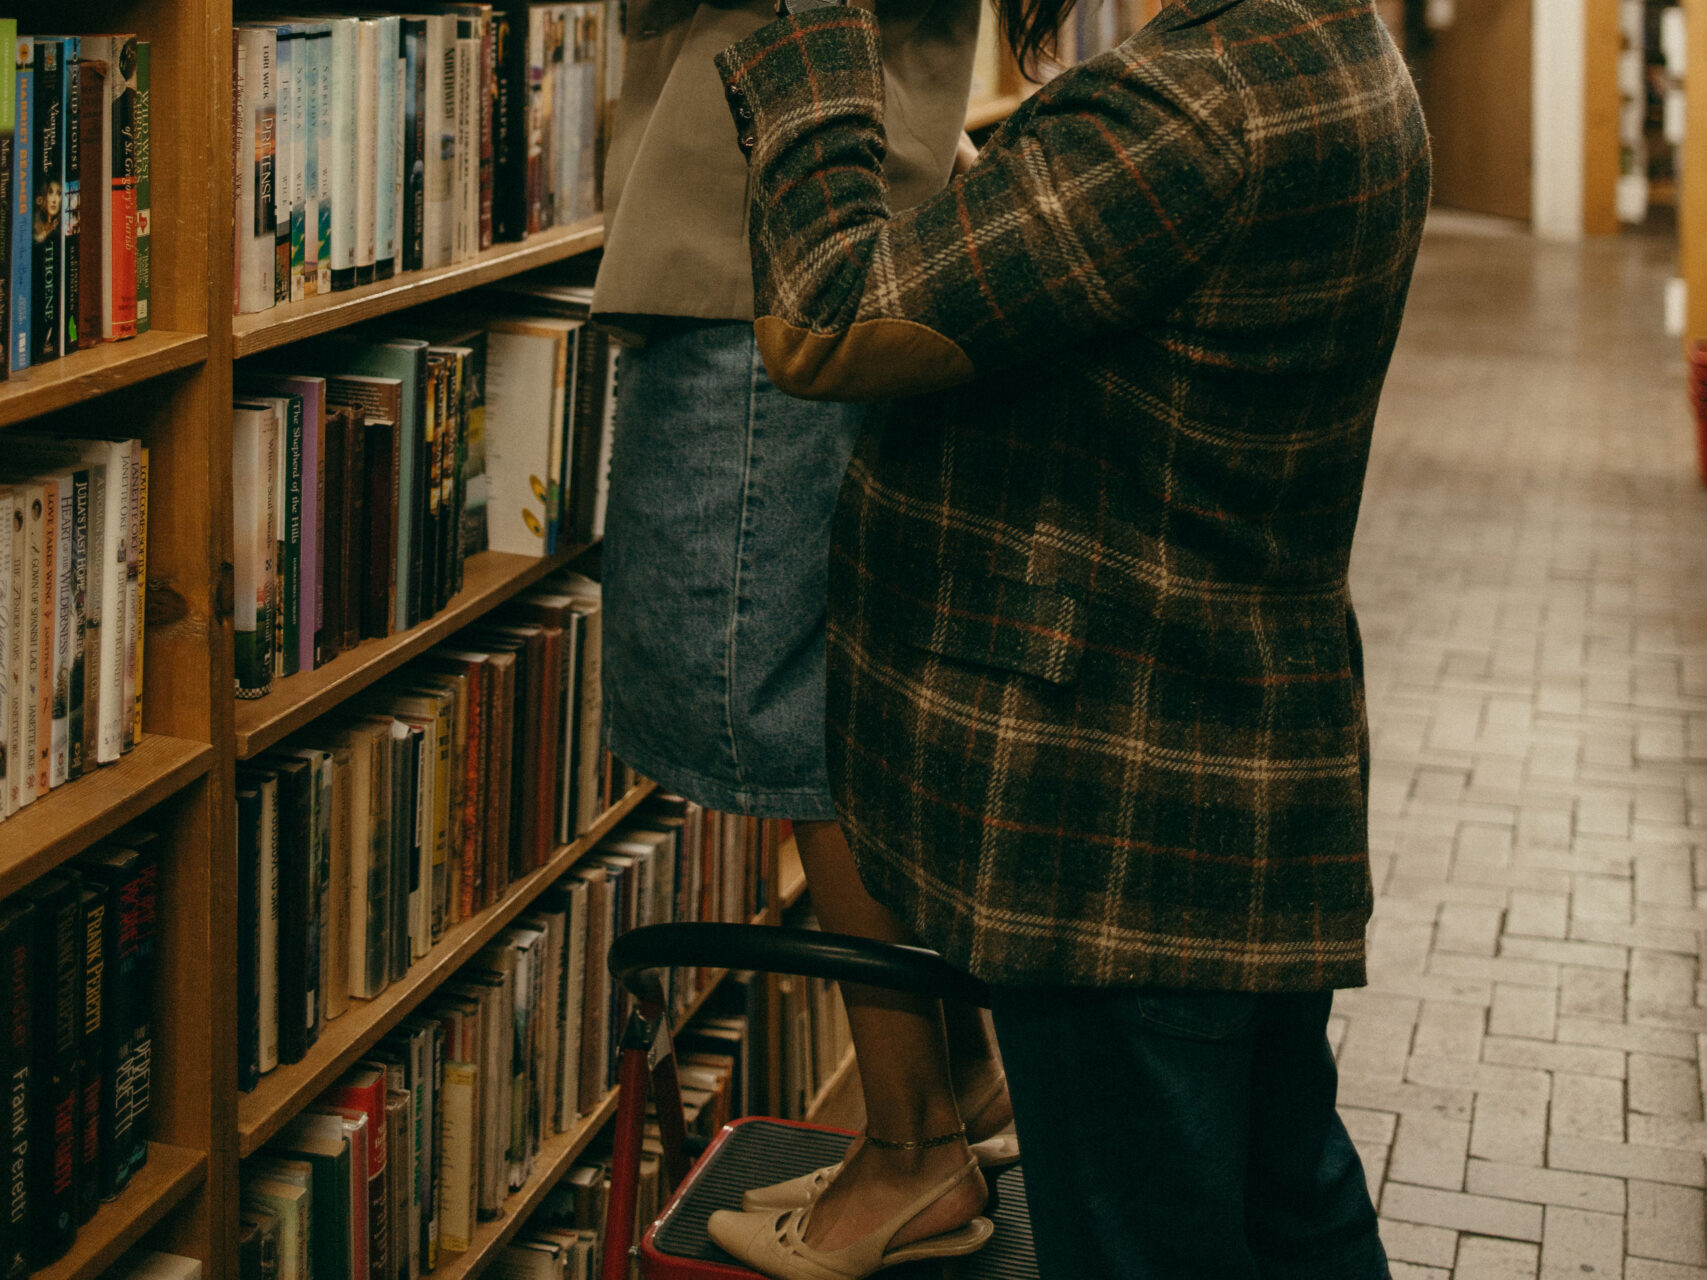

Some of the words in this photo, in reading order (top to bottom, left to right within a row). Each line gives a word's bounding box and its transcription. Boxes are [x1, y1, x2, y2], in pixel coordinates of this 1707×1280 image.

[262, 45, 270, 70] LORI
[71, 50, 80, 115] ORCHID
[262, 71, 270, 100] WICK
[19, 77, 28, 144] HARRIET
[50, 101, 60, 146] Vienna
[121, 125, 132, 138] of
[142, 89, 150, 135] WILD
[43, 127, 53, 174] Prelude
[71, 120, 79, 172] HOUSE
[124, 141, 132, 156] St.
[142, 138, 150, 183] WEST
[260, 117, 273, 204] PRETENSE
[18, 150, 28, 215] BEAMER
[121, 158, 133, 210] Gregory's
[124, 214, 134, 251] Parish
[44, 240, 54, 322] THOENE
[293, 400, 301, 424] The
[291, 426, 300, 478] Shepherd
[121, 455, 131, 502] JANETTE
[131, 461, 140, 519] JANETTE
[291, 481, 299, 493] of
[47, 493, 55, 521] LOVE
[61, 496, 73, 541] HEART
[75, 481, 88, 523] JULIA'S
[119, 506, 131, 532] OKE
[46, 528, 54, 566] TAKES
[77, 525, 88, 553] LAST
[130, 523, 139, 557] OKE
[291, 517, 299, 544] Hills
[31, 558, 39, 589] GOWN
[45, 569, 53, 605] WING
[31, 591, 39, 606] OF
[59, 569, 71, 656] WILDERNESS
[115, 599, 125, 634] GOLD
[30, 607, 39, 647] SPANISH
[29, 650, 39, 675] LACE
[113, 637, 124, 689] REFINED
[28, 704, 37, 747] JANETTE
[28, 749, 36, 771] OKE
[87, 904, 105, 966] FRANK
[85, 960, 104, 1035] PERETTI
[11, 1065, 29, 1139] Frank
[115, 1056, 134, 1140] PERETTI
[11, 1139, 29, 1224] Peretti
